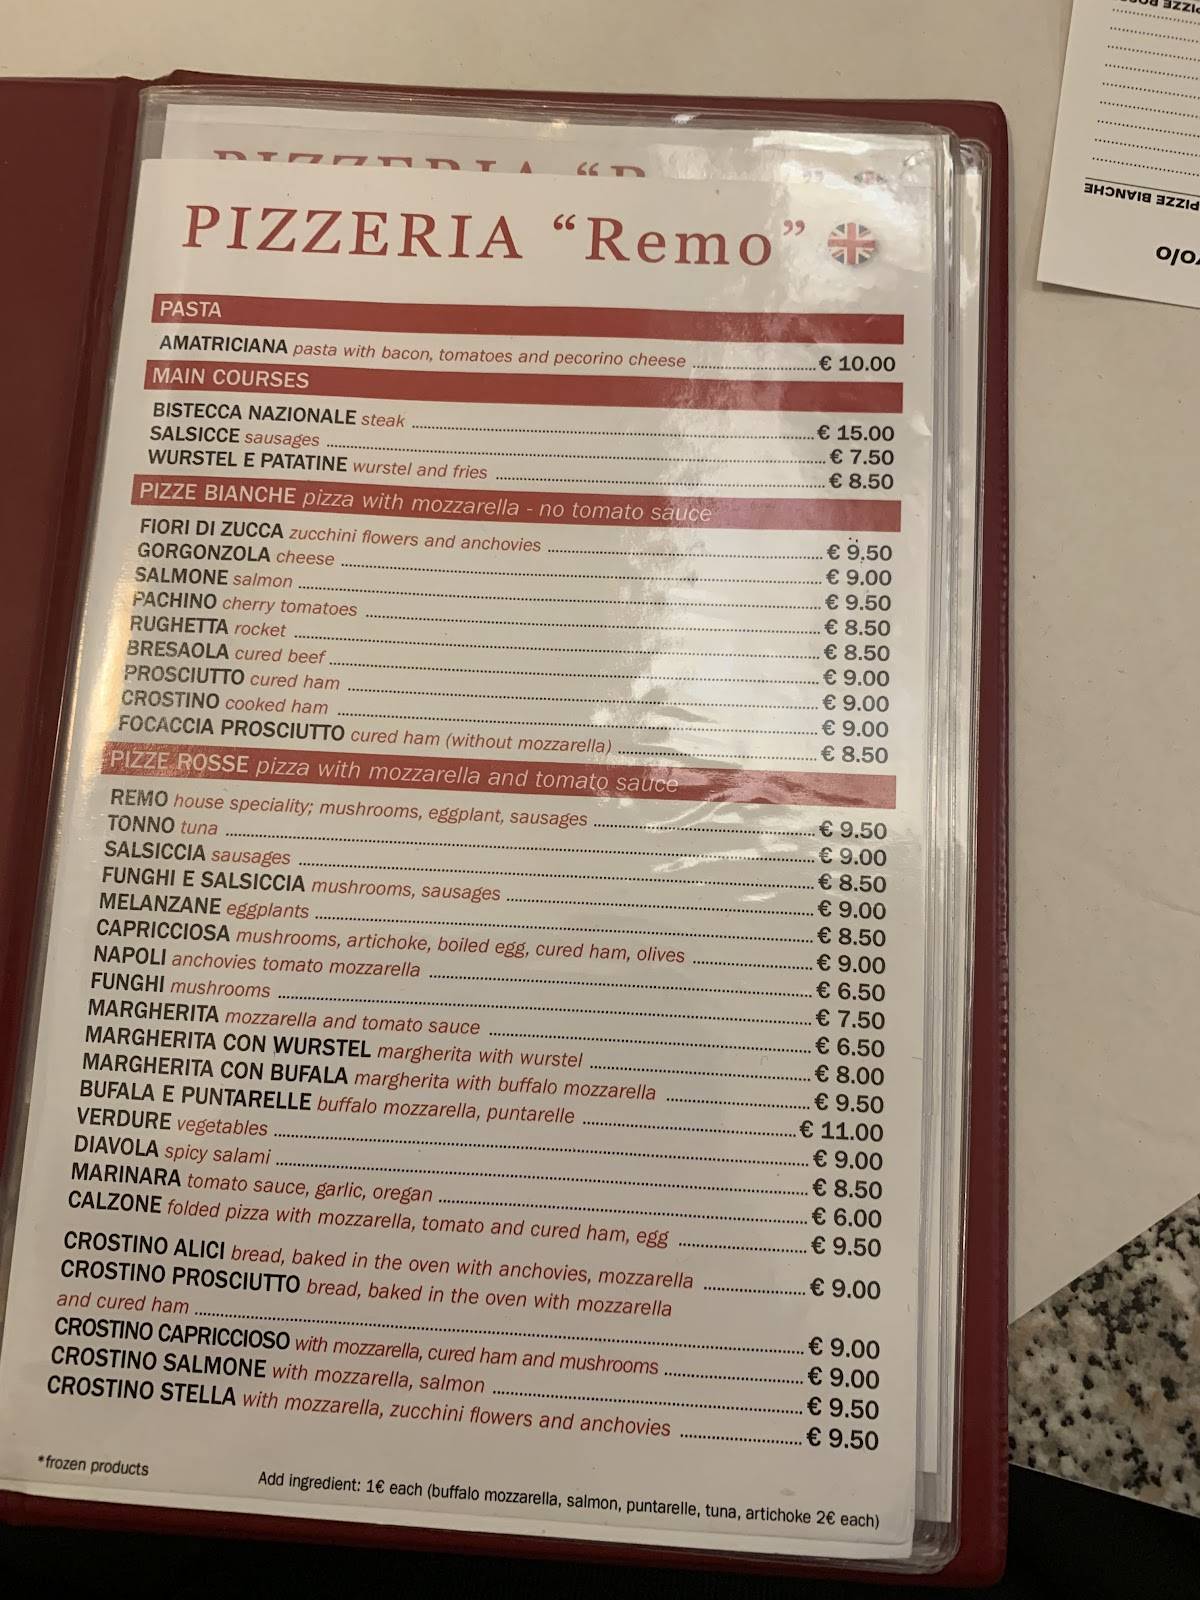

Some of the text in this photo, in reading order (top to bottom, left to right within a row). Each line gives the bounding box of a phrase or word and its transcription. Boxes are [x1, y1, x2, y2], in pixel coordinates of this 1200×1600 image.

[1084, 183, 1200, 211] PIZZE BIANCHE
[182, 204, 523, 259] PIZZERIA
[160, 301, 222, 318] PASTA
[153, 367, 309, 388] MAIN COURSES
[159, 335, 896, 372] AMATRICIANA pasta with bacon, tomatoes and pecorino cheese € 10.00
[149, 425, 894, 466] SALSICCE sausages € 7.50
[153, 402, 894, 442] BISTECCA NAZIONALE steak € 15.00
[140, 482, 197, 500] PIZZE
[205, 484, 296, 504] BIANCHE
[302, 492, 354, 508] pizza
[363, 492, 403, 510] with
[411, 498, 519, 516] mozzarella
[539, 503, 564, 517] no
[572, 502, 643, 520] tomato
[650, 507, 712, 522] sauce
[137, 541, 892, 586] GORGONZOLA cheese € 9.00
[140, 518, 893, 561] FIORI DI ZUCCA zucchini flowers and anchovies € 9.50
[132, 590, 891, 637] PACHINO cherry tomatoes € 8.50
[121, 688, 889, 738] CROSTINO cooked ham € 9.00
[110, 750, 679, 794] PIZZE ROSSE pizza with mozzarella and tomato sauce
[104, 840, 886, 894] SALSICCIA sausages € 8.50
[99, 892, 886, 947] MELANZANE eggplants € 8.50
[91, 971, 885, 1030] FUNGHI mushrooms € 7.50
[82, 1052, 884, 1114] MARGHERITA CON BUFALA margherita with buffalo mozzarella € 9.50
[77, 1106, 883, 1171] VERDURE vegetables € 9.00
[74, 1134, 882, 1200] DIAVOLA spicy salami € 8.50
[71, 1162, 882, 1229] MARINARA tomato sauce, garlic, oregan € 6.00
[68, 1190, 881, 1258] CALZONE folded pizza with mozzarella, tomato and cured ham, egg € 9.50
[55, 1316, 879, 1390] CROSTINO CAPRICCIOSO with mozzarella, cured ham and mushrooms € 9.00
[47, 1374, 879, 1451] CROSTINO STELLA with mozzarella, zucchini flowers and anchovies € 9.50
[90, 1460, 149, 1477] products
[258, 1471, 879, 1530] Add ingredient: 1€ each (buffalo mozzarella, salmon, puntarelle, tuna, artichoke 2€ each)
